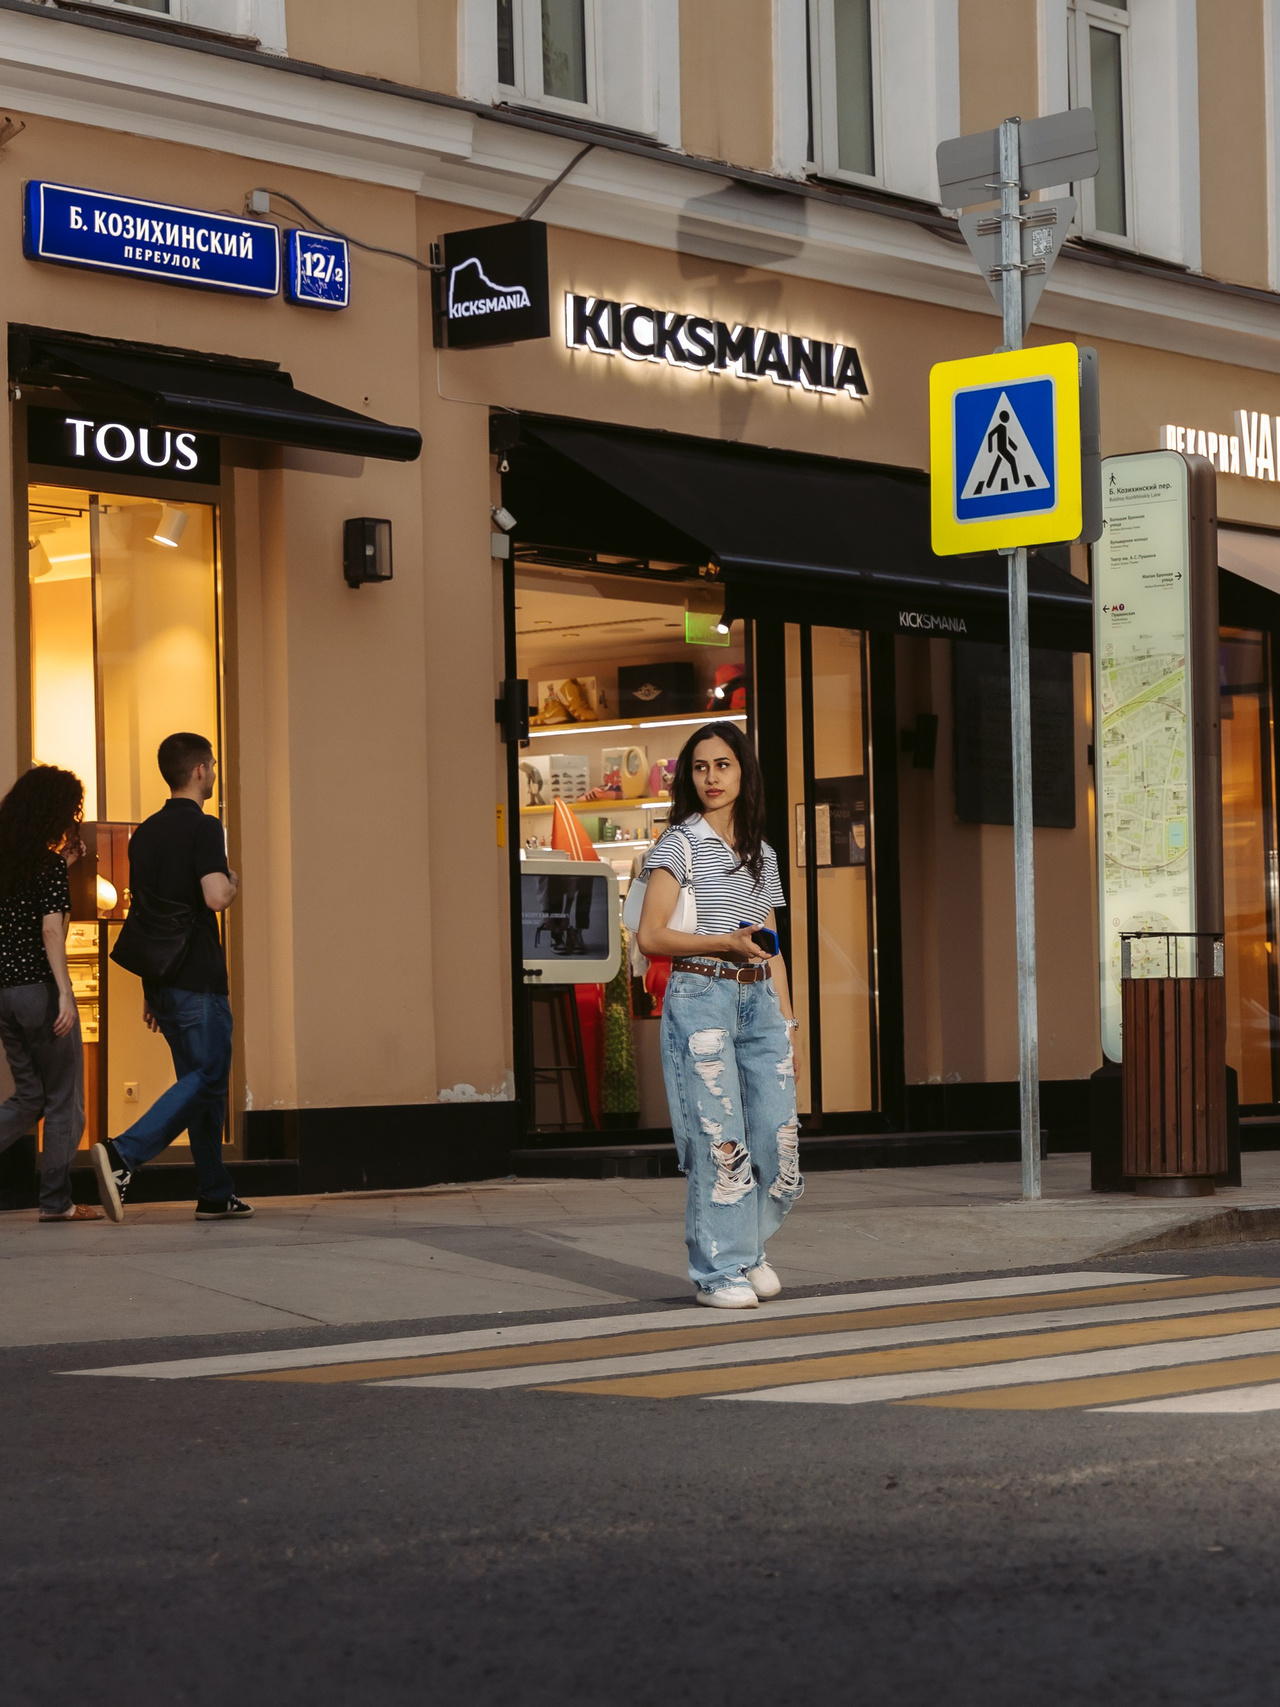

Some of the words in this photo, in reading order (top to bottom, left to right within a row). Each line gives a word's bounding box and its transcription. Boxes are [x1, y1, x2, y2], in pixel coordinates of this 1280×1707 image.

[69, 205, 88, 232] Б.
[94, 209, 253, 260] КОЗИХИНСКИЙ
[124, 245, 201, 270] ПЕРЕУЛОК
[303, 251, 343, 283] 12/2
[448, 291, 531, 319] KICKSMANIA
[567, 293, 869, 397] KICKSMANIA
[65, 417, 199, 471] TOUS
[1117, 484, 1157, 494] Козихинский
[899, 611, 967, 633] KICKSMANIA
